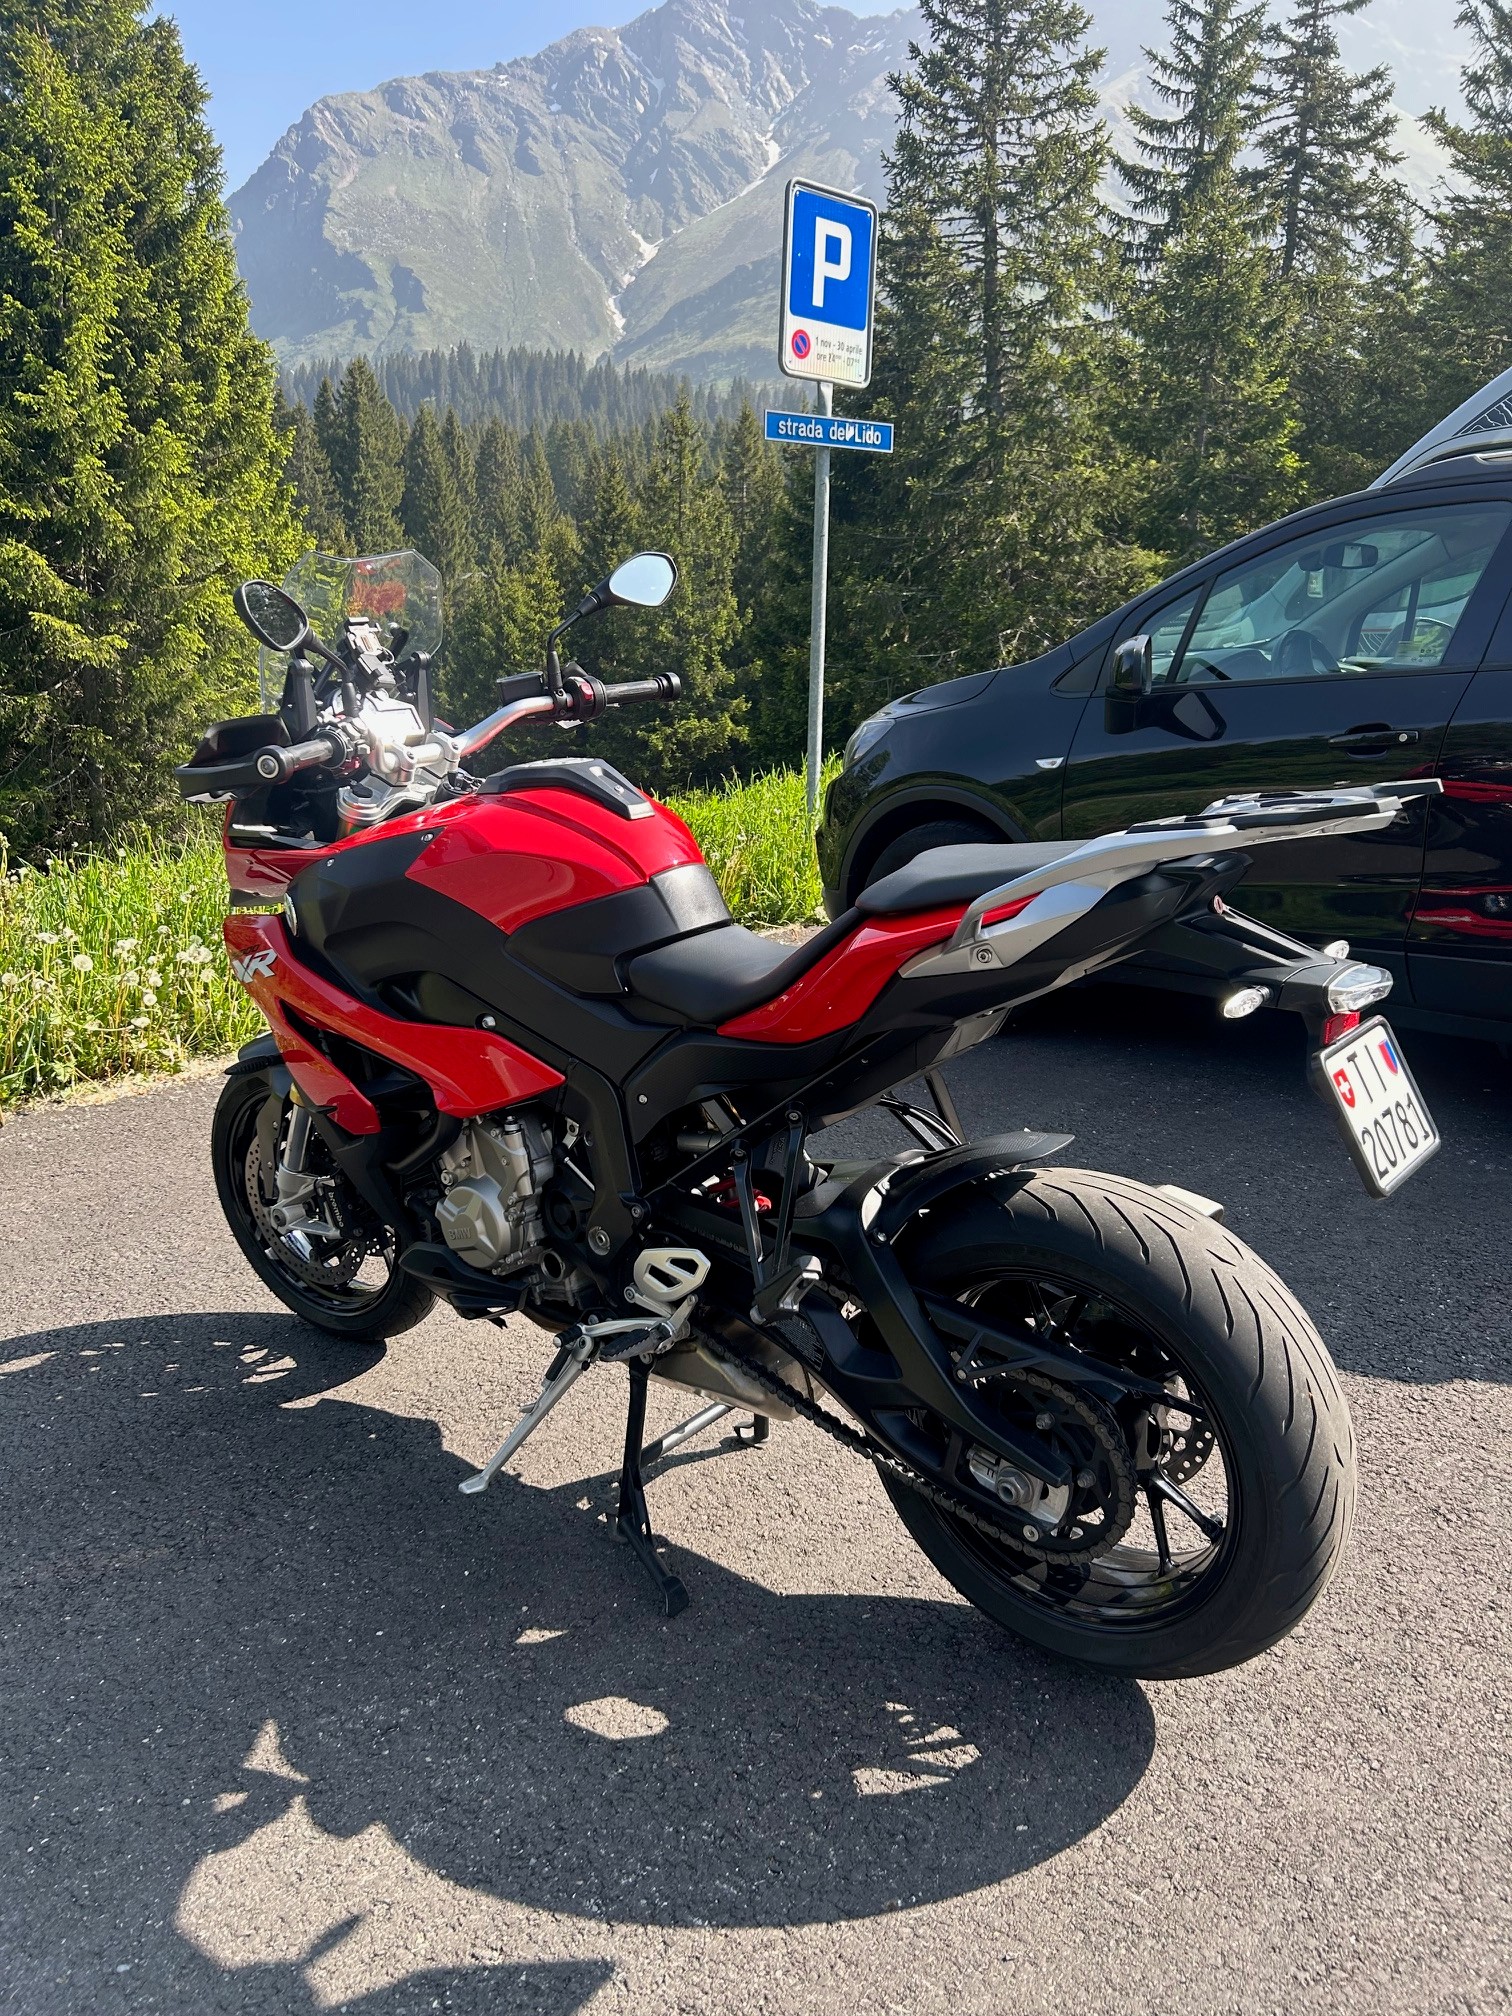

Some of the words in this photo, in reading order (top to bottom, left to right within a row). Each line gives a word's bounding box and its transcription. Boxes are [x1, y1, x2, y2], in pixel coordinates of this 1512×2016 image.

[811, 216, 852, 308] P
[815, 336, 819, 346] 1
[820, 339, 832, 348] nov
[837, 341, 845, 351] 30
[846, 344, 863, 356] aprile
[816, 353, 827, 361] ore
[778, 418, 824, 439] strada
[829, 421, 850, 442] del
[854, 424, 882, 445] Lido
[232, 948, 278, 984] XR
[1346, 1044, 1387, 1104] TI
[1361, 1092, 1430, 1181] 20781
[327, 1191, 344, 1228] brembo
[448, 1228, 472, 1240] BMW
